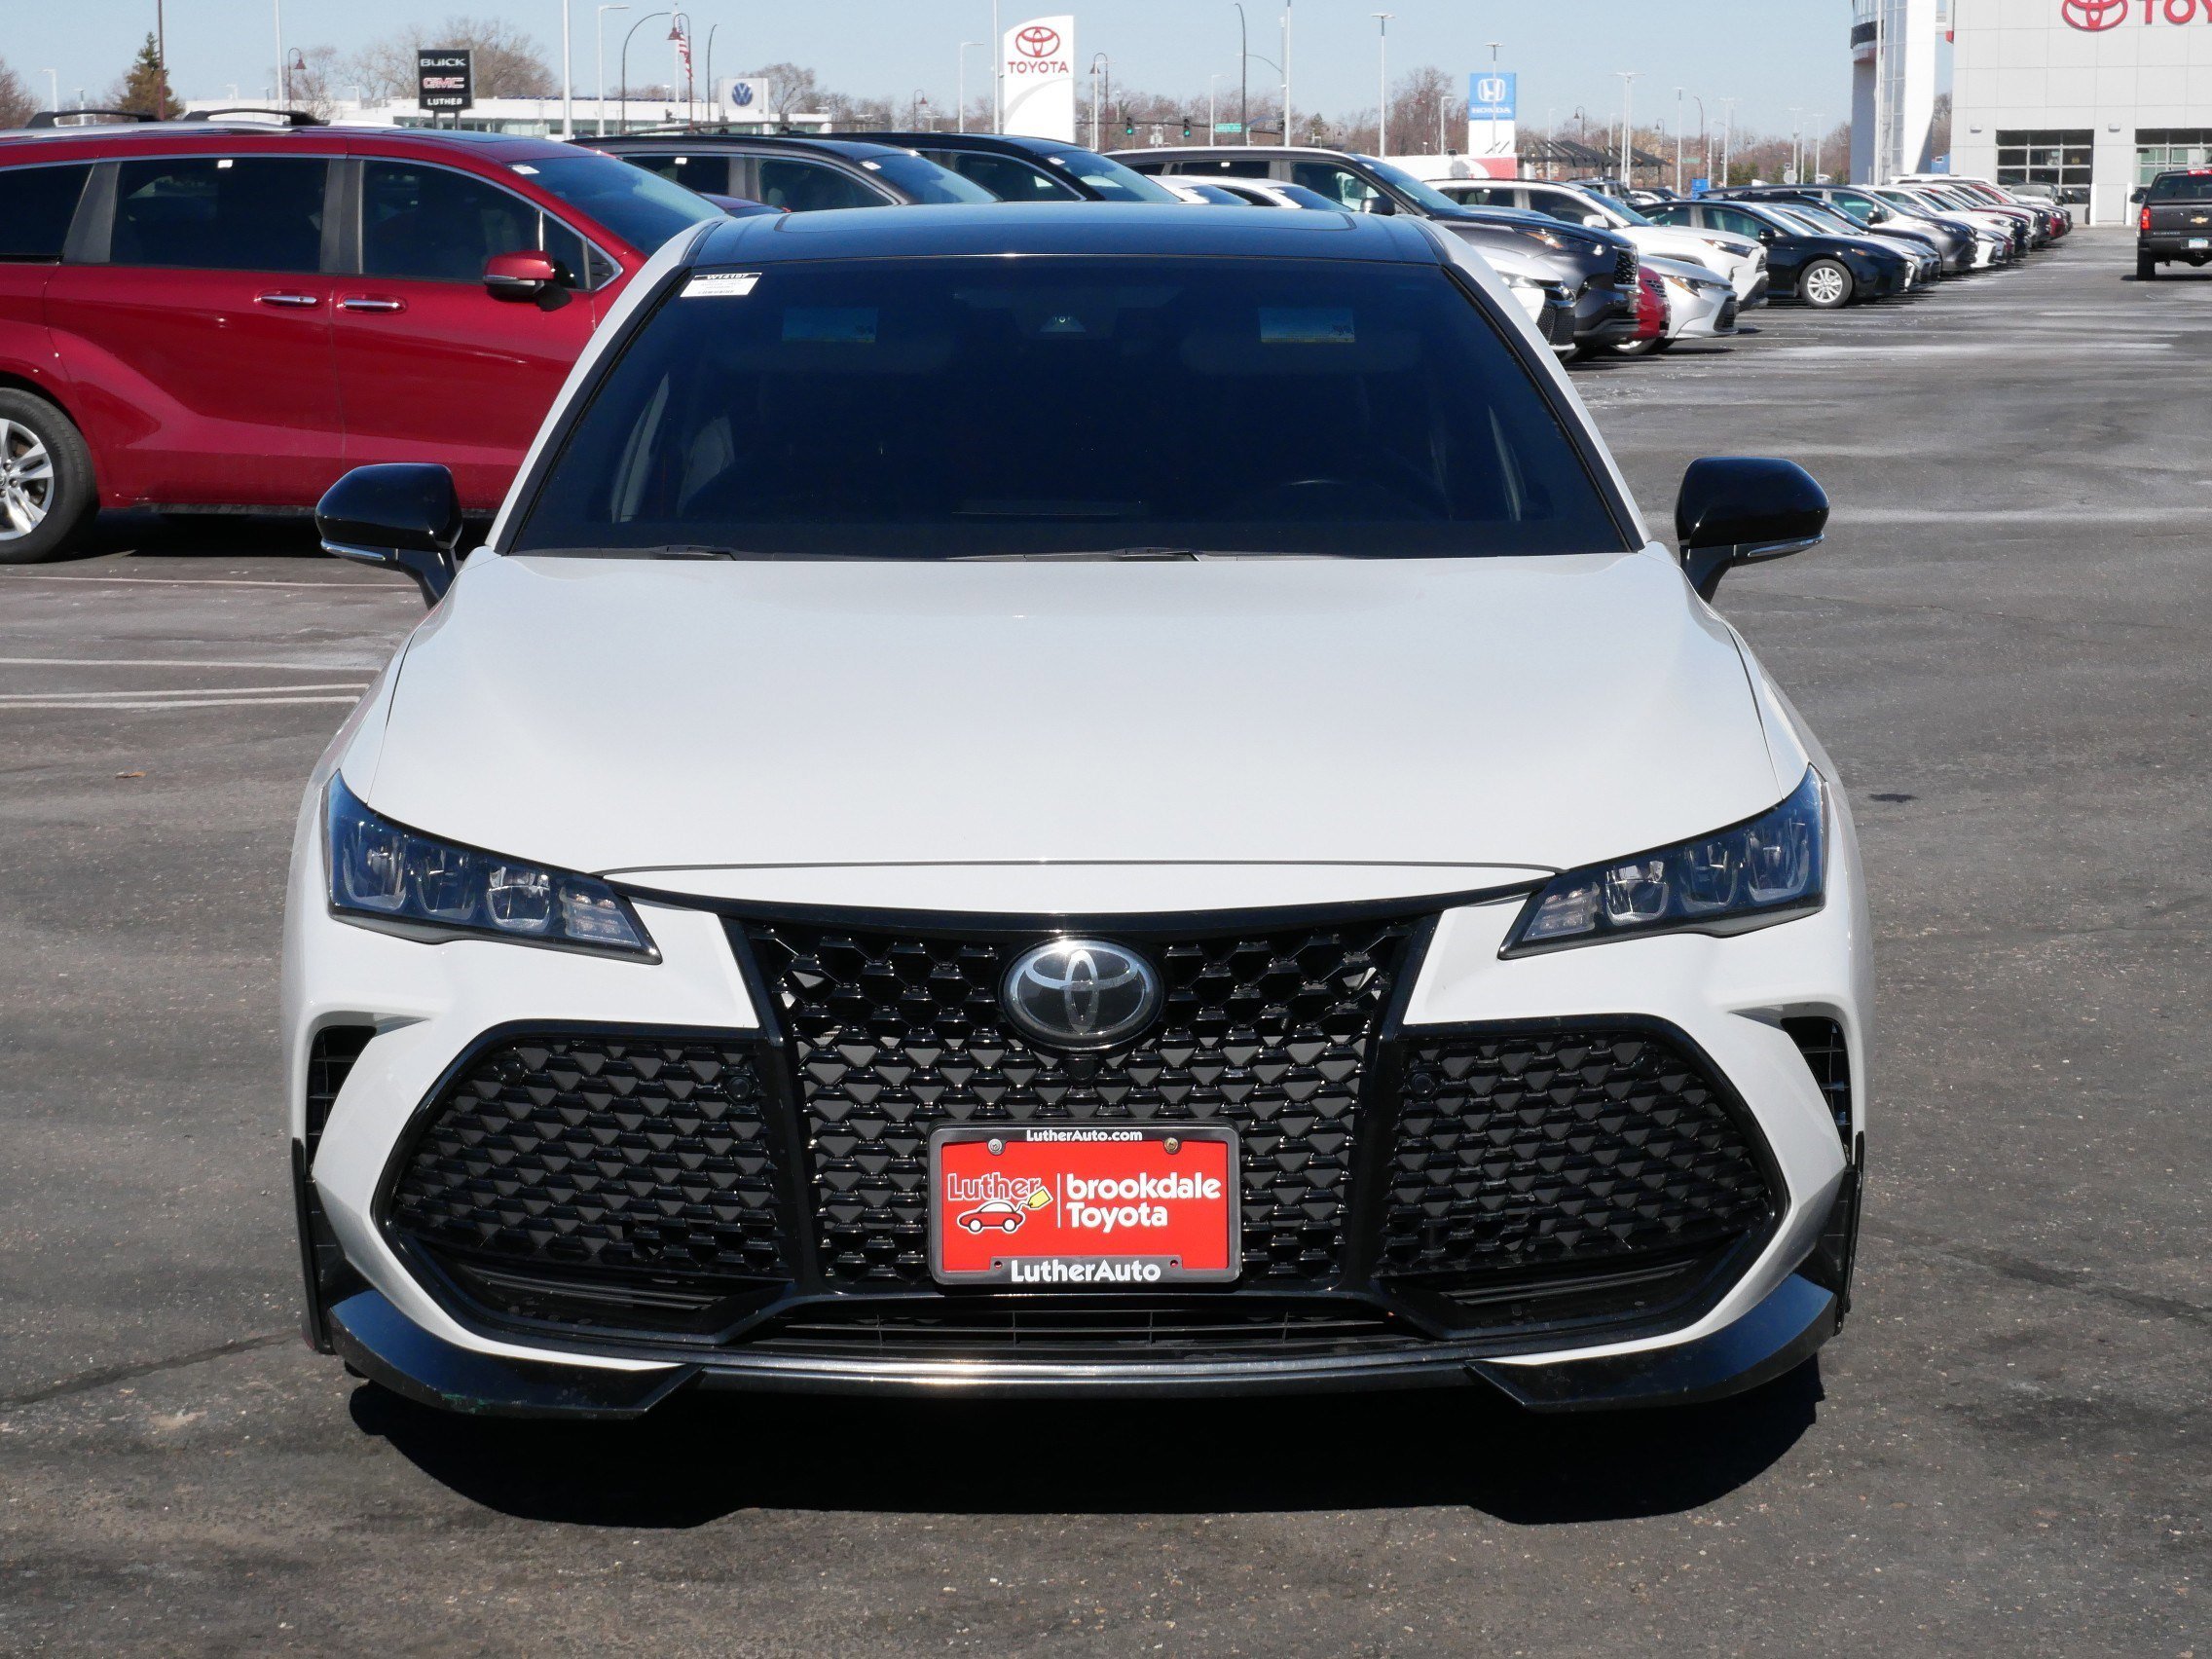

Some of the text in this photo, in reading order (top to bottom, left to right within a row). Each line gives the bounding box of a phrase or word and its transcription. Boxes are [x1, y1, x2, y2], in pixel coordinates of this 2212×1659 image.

[421, 58, 466, 67] BUICK
[1007, 61, 1069, 74] TOYOTA
[423, 77, 464, 89] GMC
[426, 97, 462, 106] LUTHER
[1026, 1128, 1143, 1142] LutherAuto.com
[947, 1172, 1041, 1202] Luther
[1066, 1171, 1222, 1200] brookdale
[1065, 1201, 1168, 1234] Toyota
[1011, 1259, 1161, 1282] LutherAuto
